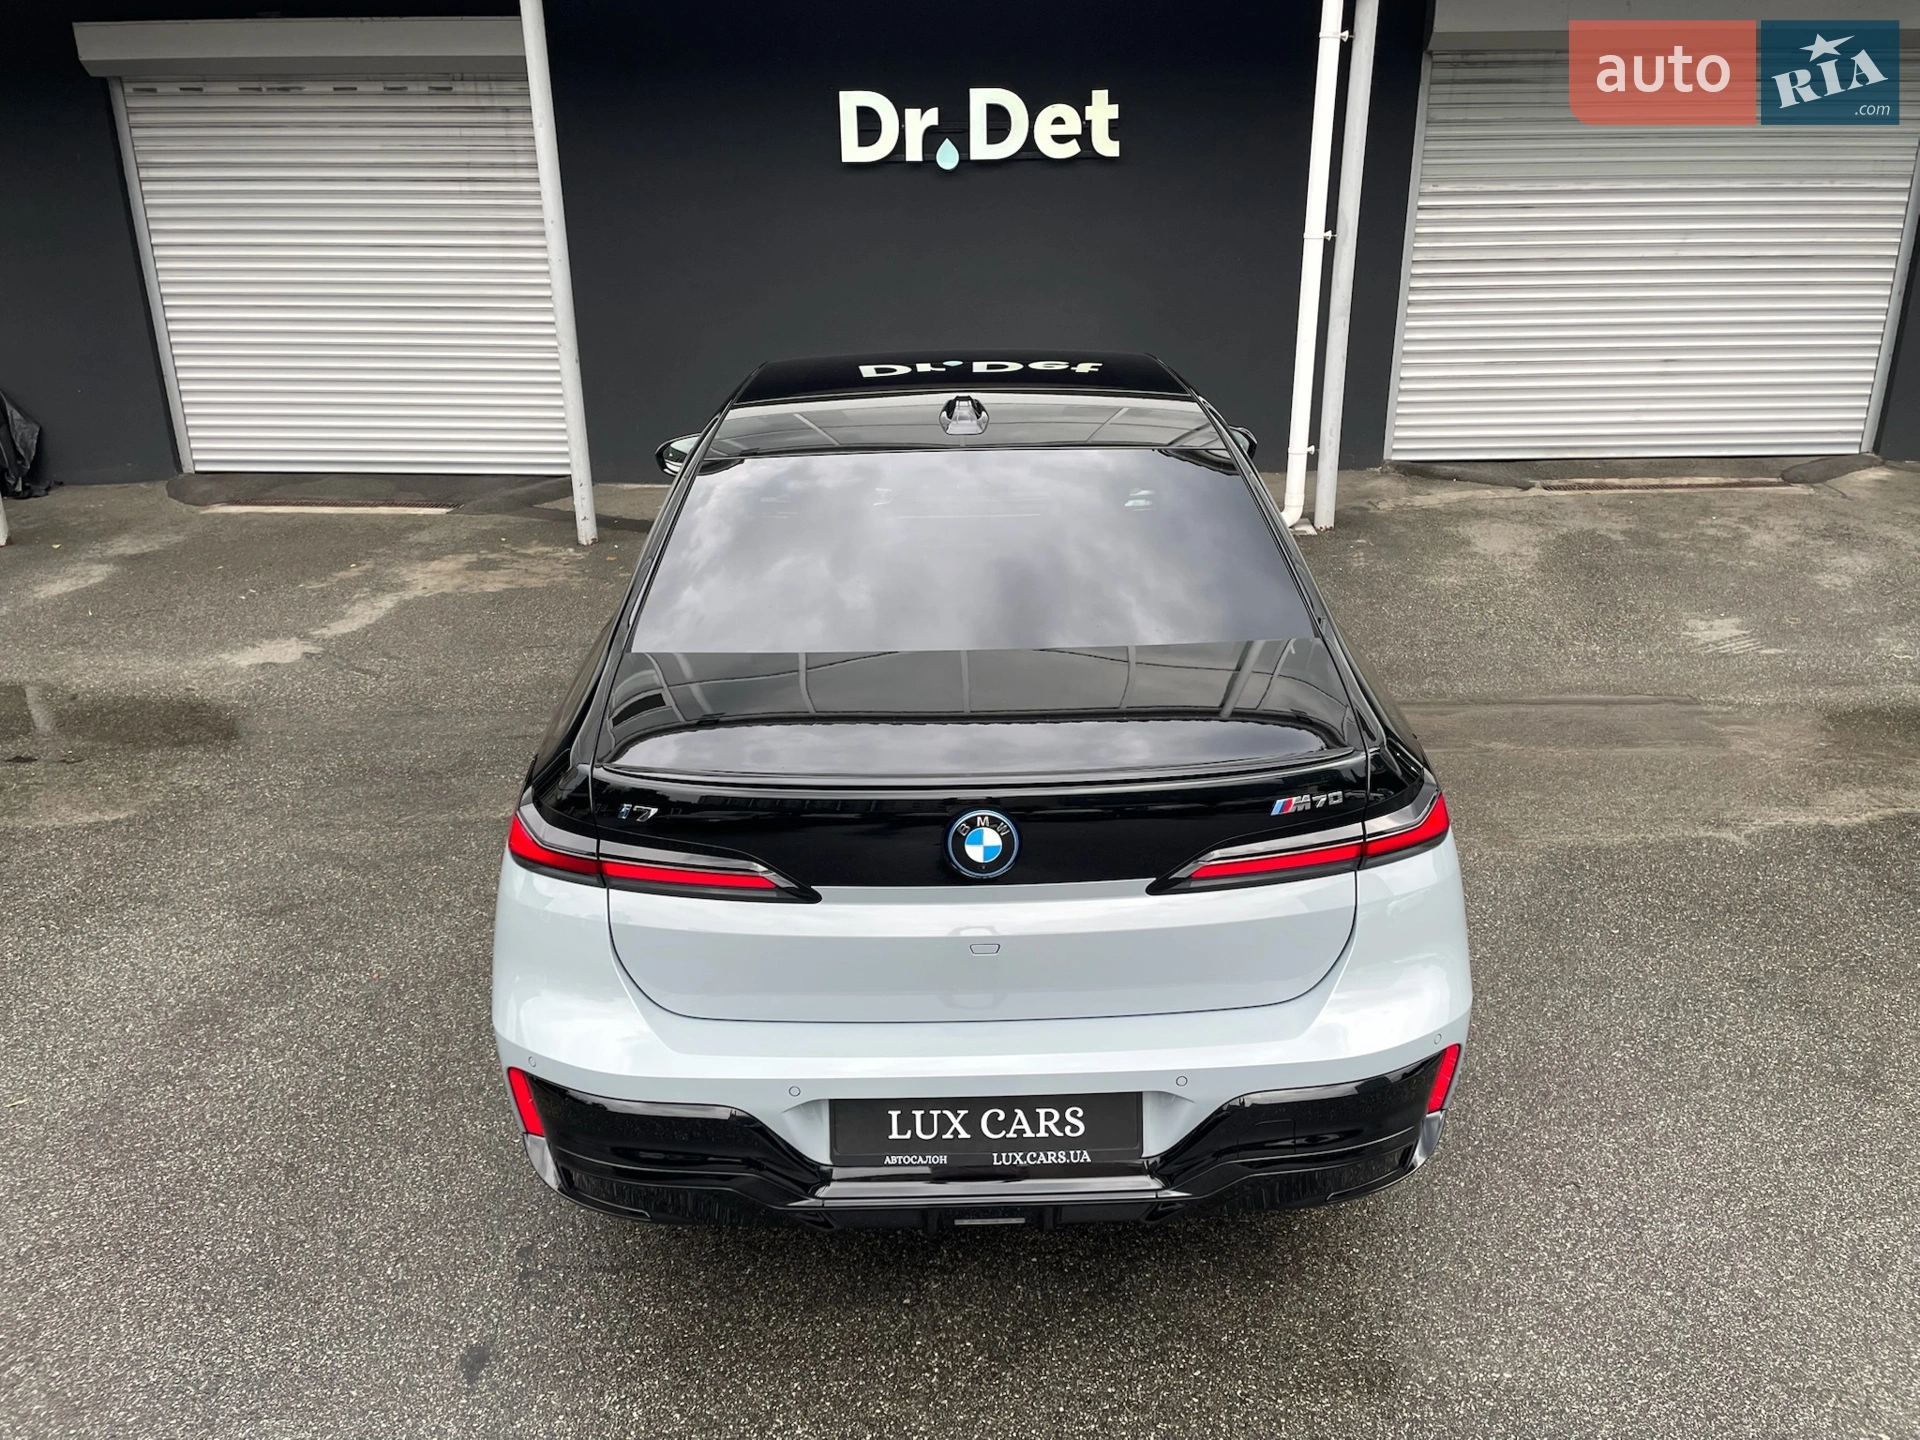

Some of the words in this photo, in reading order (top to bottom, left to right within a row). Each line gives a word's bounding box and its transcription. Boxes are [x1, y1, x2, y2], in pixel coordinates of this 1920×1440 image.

[957, 816, 1010, 836] BMW
[888, 1110, 971, 1139] LUX
[981, 1107, 1086, 1139] CARS
[884, 1155, 947, 1164] АВТОСАЛОН
[992, 1150, 1091, 1165] LUX.CARS.UA
